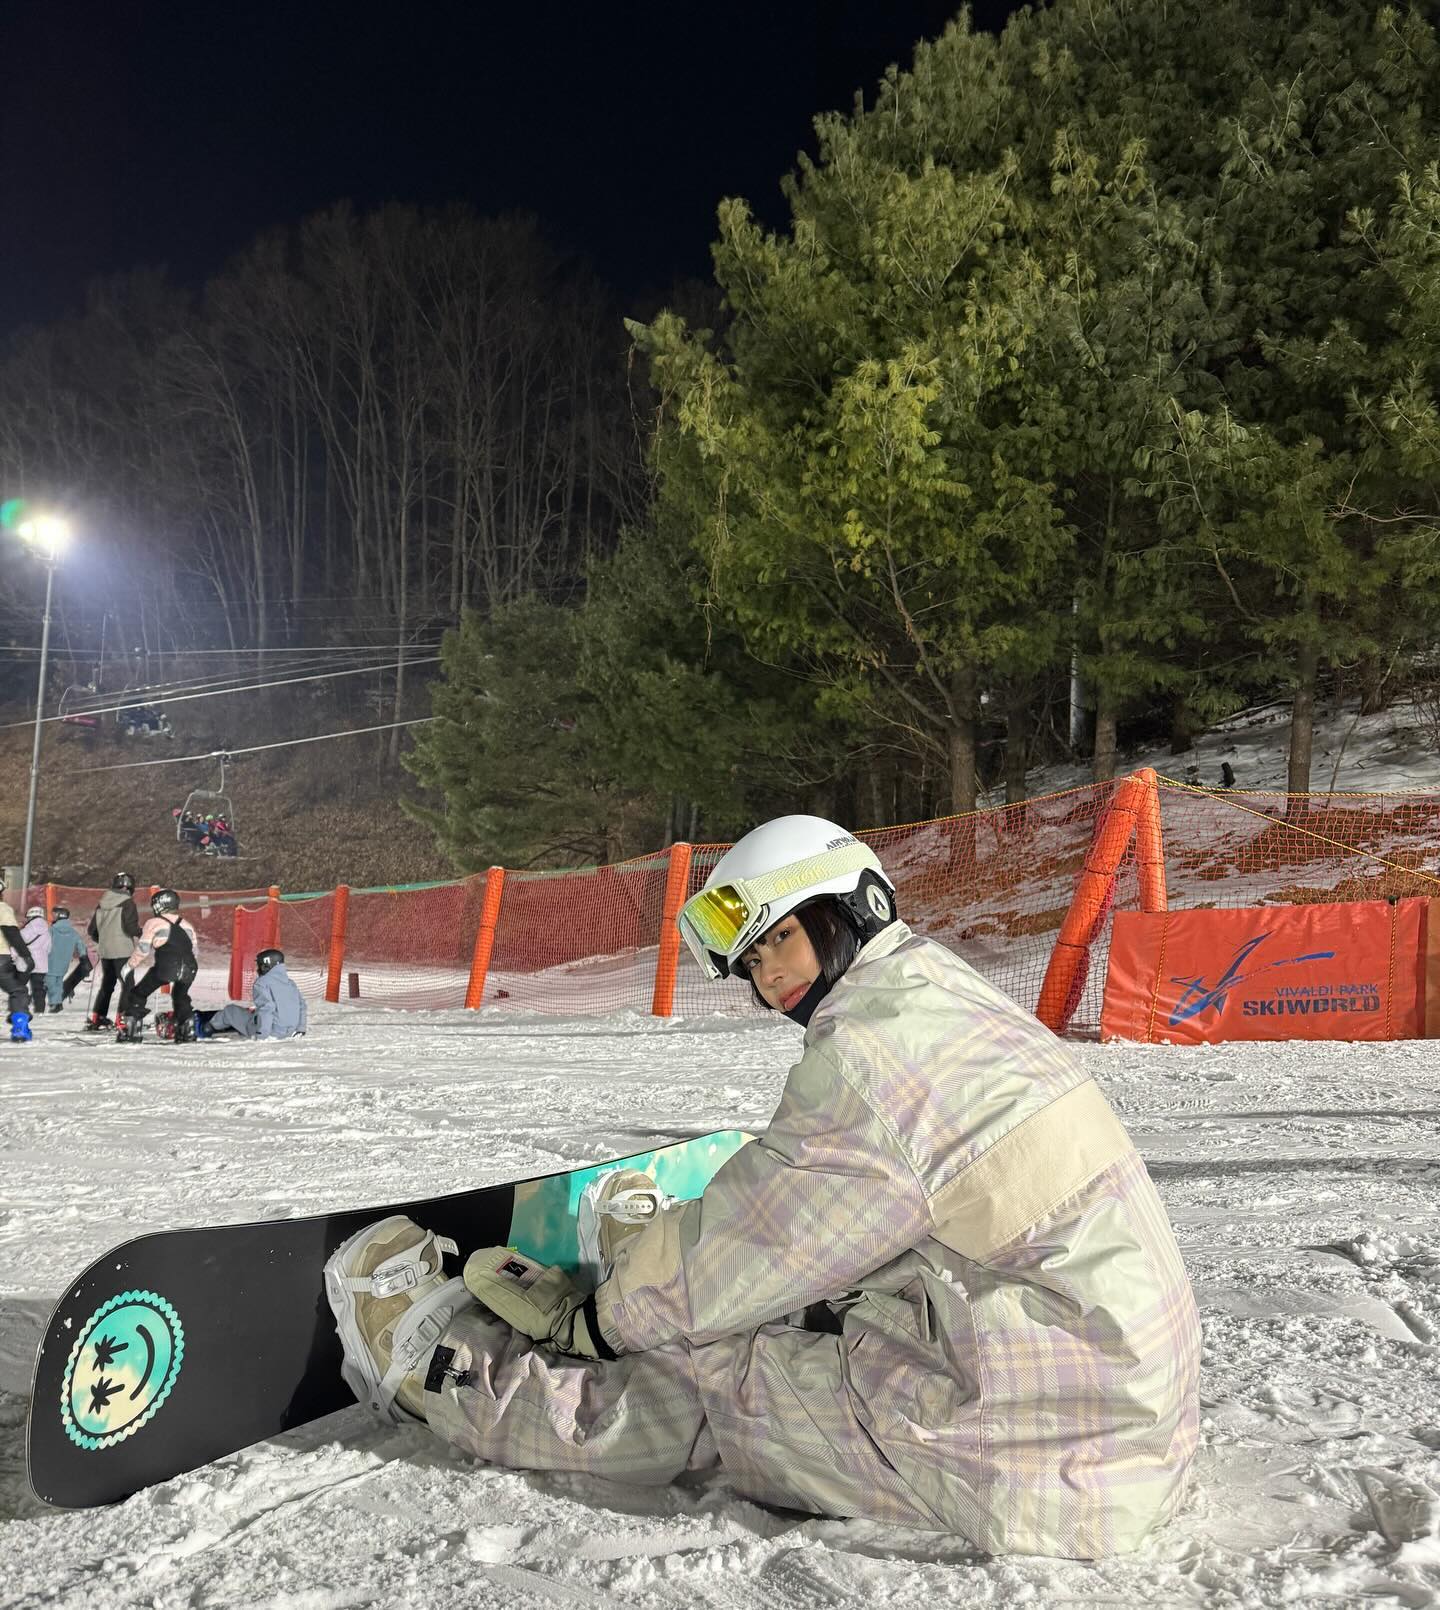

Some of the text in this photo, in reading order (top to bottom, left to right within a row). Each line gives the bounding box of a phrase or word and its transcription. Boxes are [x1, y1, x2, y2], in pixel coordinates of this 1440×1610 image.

[1276, 983, 1378, 997] VIVALDI PARK
[1243, 995, 1380, 1016] SKIWORLD
